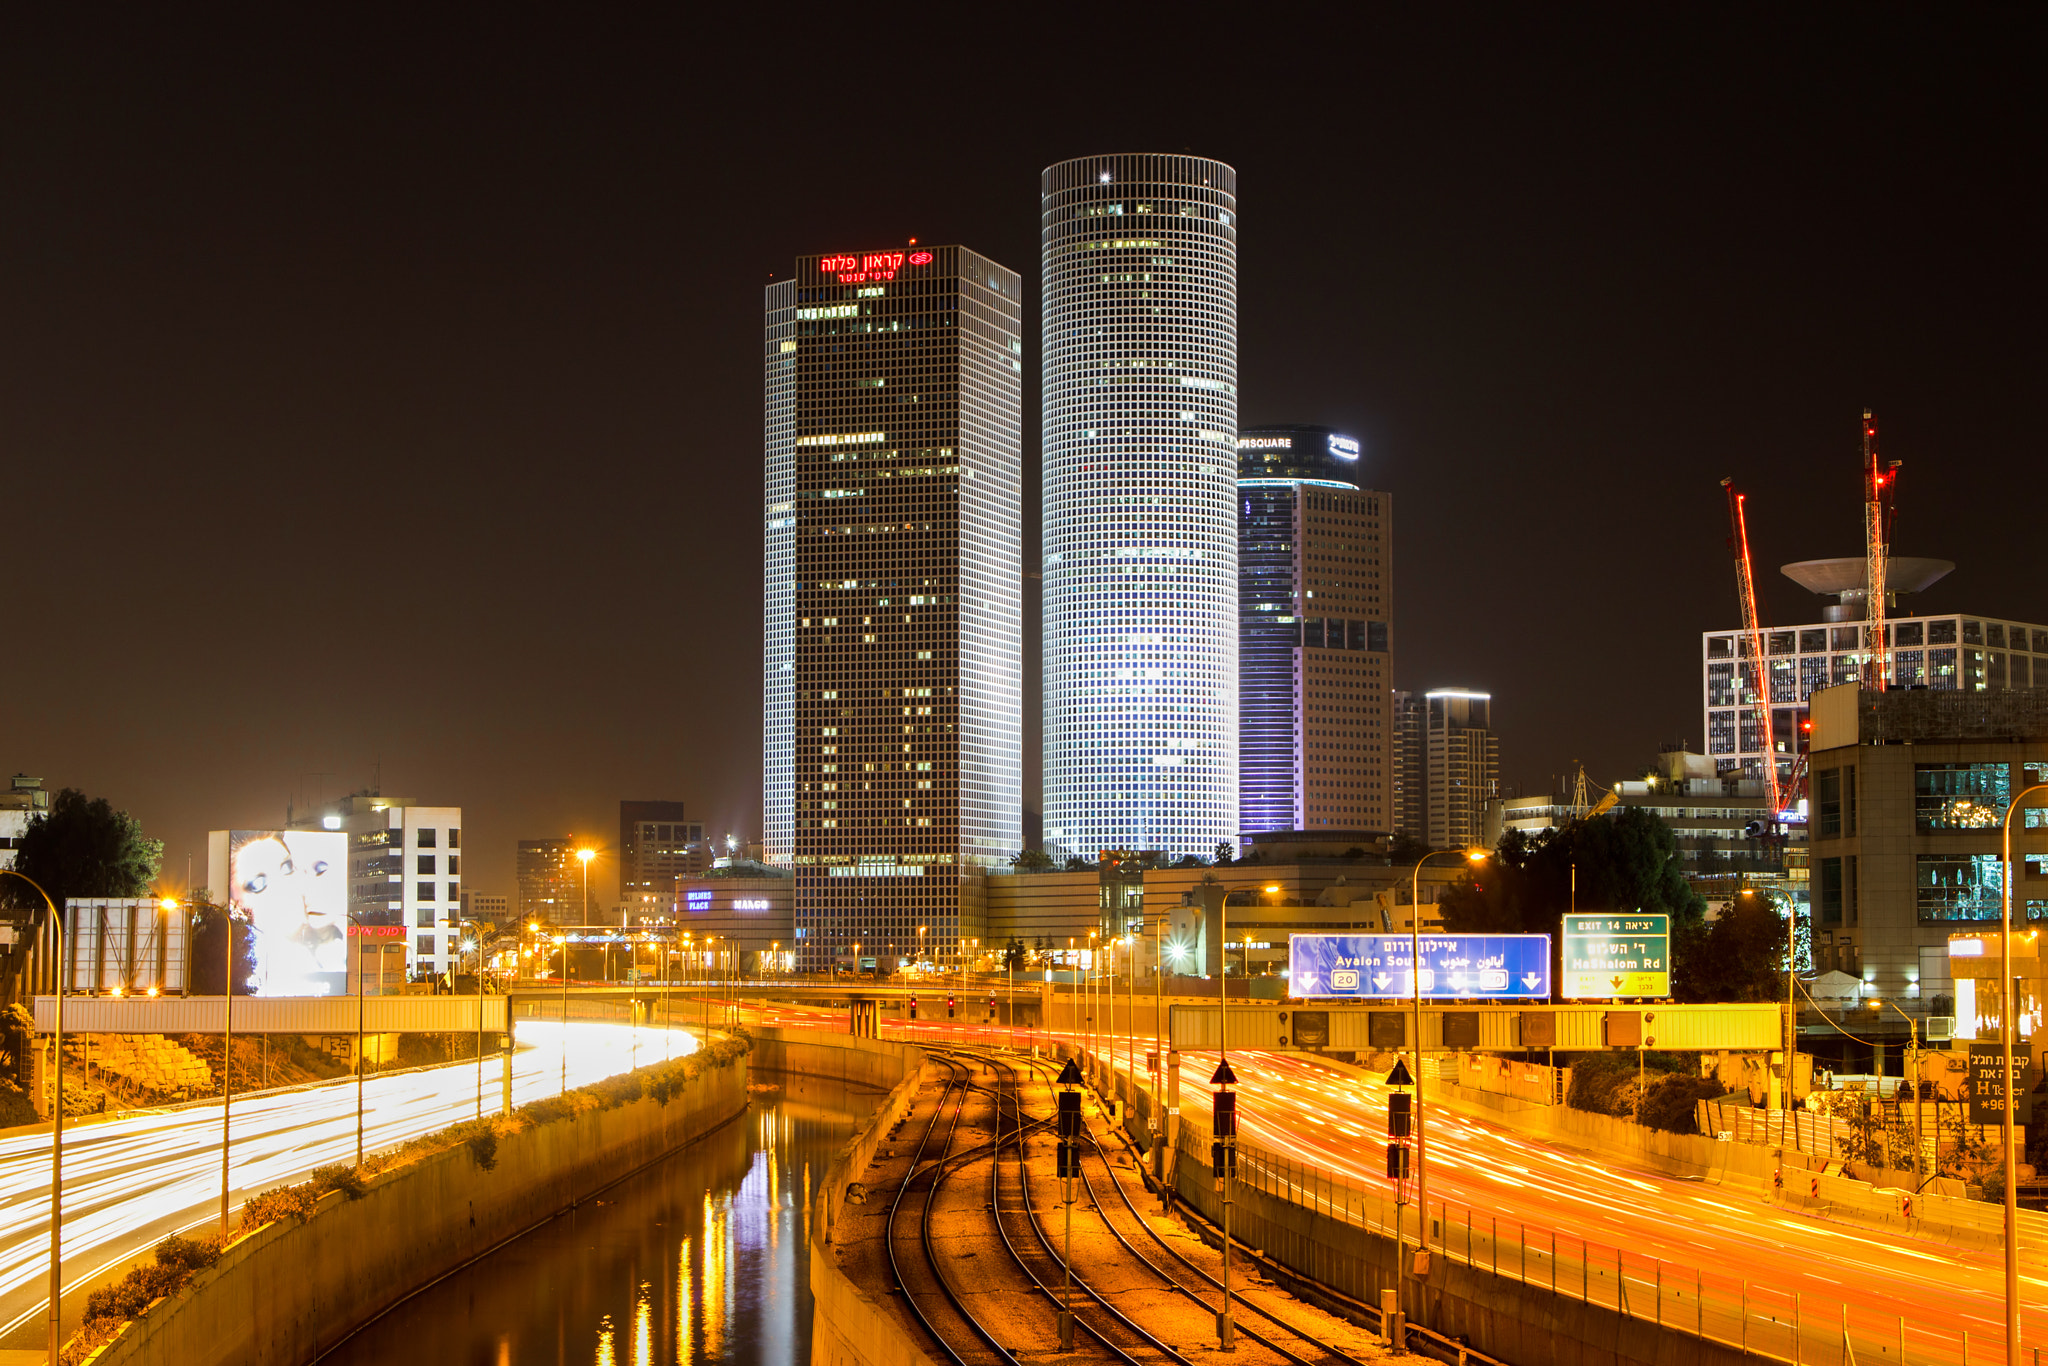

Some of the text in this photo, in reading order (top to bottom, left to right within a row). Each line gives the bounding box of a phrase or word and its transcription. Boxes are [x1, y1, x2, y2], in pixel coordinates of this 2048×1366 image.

[821, 254, 904, 272] קראון פלזה
[838, 271, 895, 282] סיטי סנטר
[689, 902, 709, 911] PLACE
[734, 899, 769, 910] MANGO
[1577, 921, 1621, 930] EXIT 14
[1625, 921, 1654, 930] יציאה
[1383, 939, 1458, 954] איילון דרום
[1633, 942, 1646, 954] ד'
[1335, 955, 1426, 968] Ayalon Souh
[1439, 955, 1471, 970] جنوب
[1573, 957, 1661, 970] HaShalom Rd
[1337, 975, 1353, 985] 20
[1995, 1055, 2030, 1070] קבות
[1979, 1068, 2021, 1080] בה את
[1976, 1080, 2025, 1096] H Toer
[1980, 1098, 2020, 1111] 964
